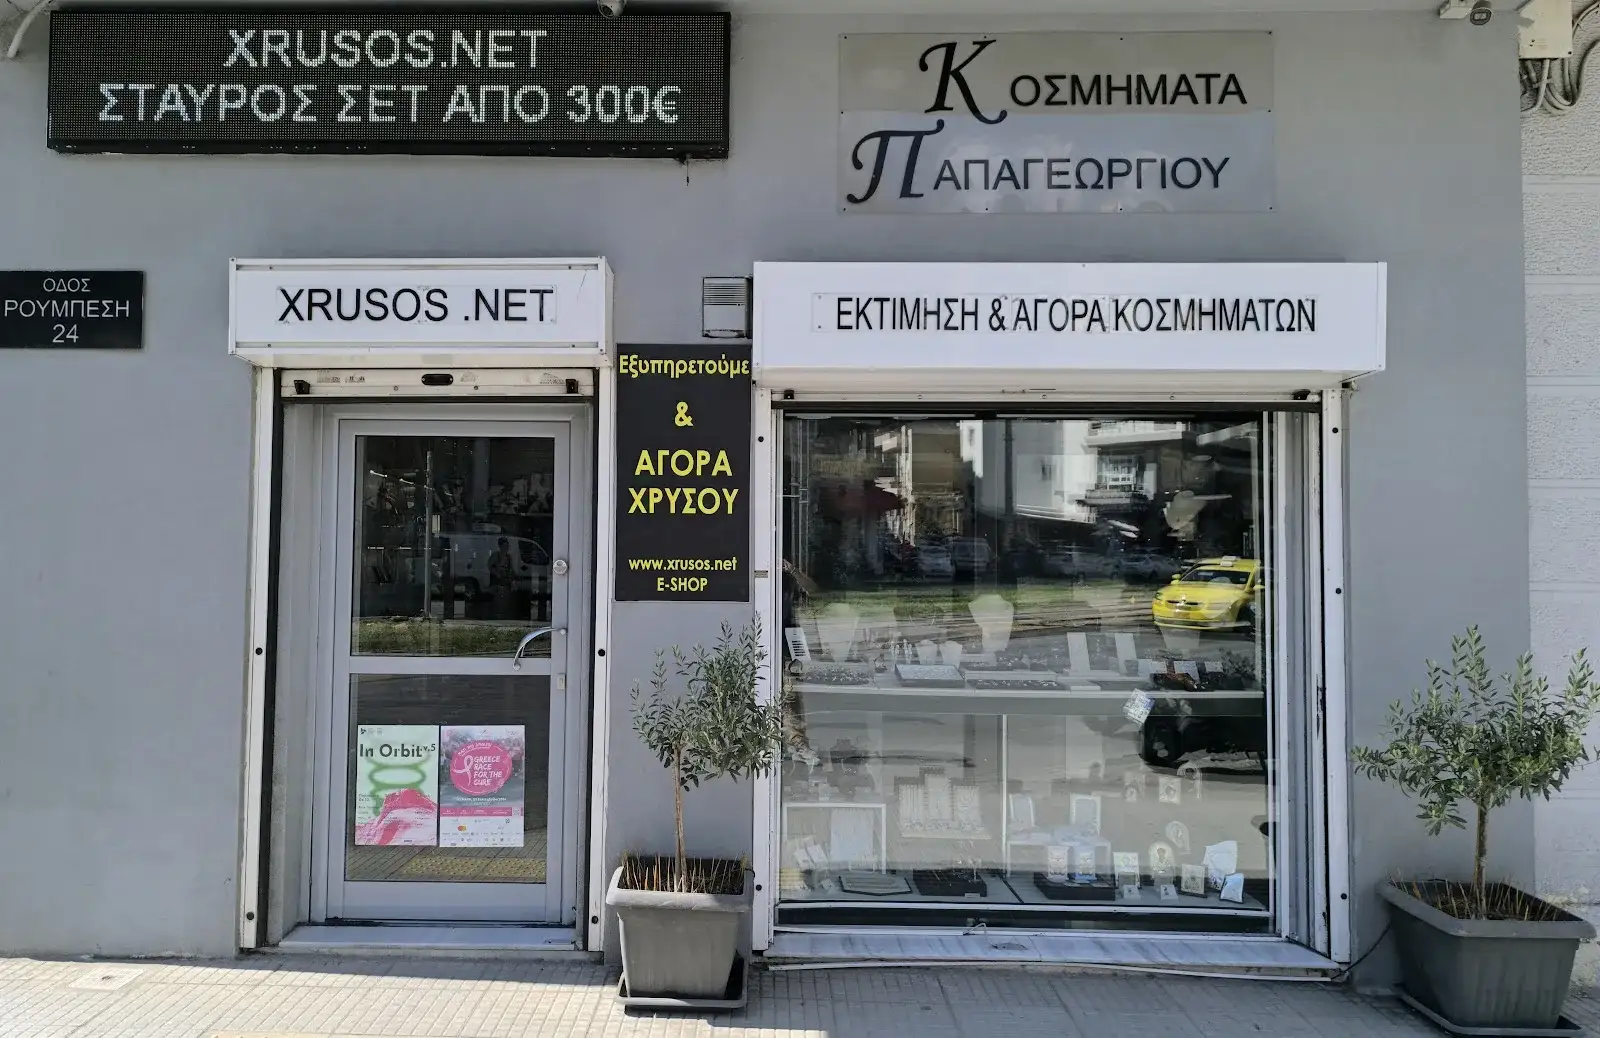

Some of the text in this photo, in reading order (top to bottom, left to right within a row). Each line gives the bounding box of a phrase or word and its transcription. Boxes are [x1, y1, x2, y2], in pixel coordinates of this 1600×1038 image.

[223, 29, 548, 69] XRUSOS.NET
[918, 39, 1248, 126] ΚΟΣΜΗΜΑΤΑ
[98, 82, 682, 124] ΣΤΑΥΡΟΣ ΣΕΤ ΑΠΟ 300€
[847, 119, 1230, 205] ΠΑΠΑΓΕΩΡΓΙΟΥ
[43, 278, 91, 292] ΟΔΟΣ
[4, 299, 130, 318] ΡΟΥΜΠΕΣΗ
[278, 287, 554, 323] XRUSOS .NET
[837, 297, 1316, 332] ΕΚΤΙΜΗΣΗ & ΑΓΟΡΑ ΚΟΣΜΗΜΑΤΩΝ
[52, 324, 79, 343] 24
[619, 354, 750, 378] Εξυπηρετούμε
[674, 401, 694, 427] &
[635, 449, 733, 477] ΑΓΟΡΑ
[628, 487, 739, 515] ΧΡΥΣΟΥ
[629, 556, 737, 571] www.xrusos.net
[656, 576, 708, 592] E-SHOP
[359, 743, 374, 758] In
[473, 755, 501, 763] GREECE
[473, 763, 492, 771] RACE
[473, 778, 492, 787] CURE
